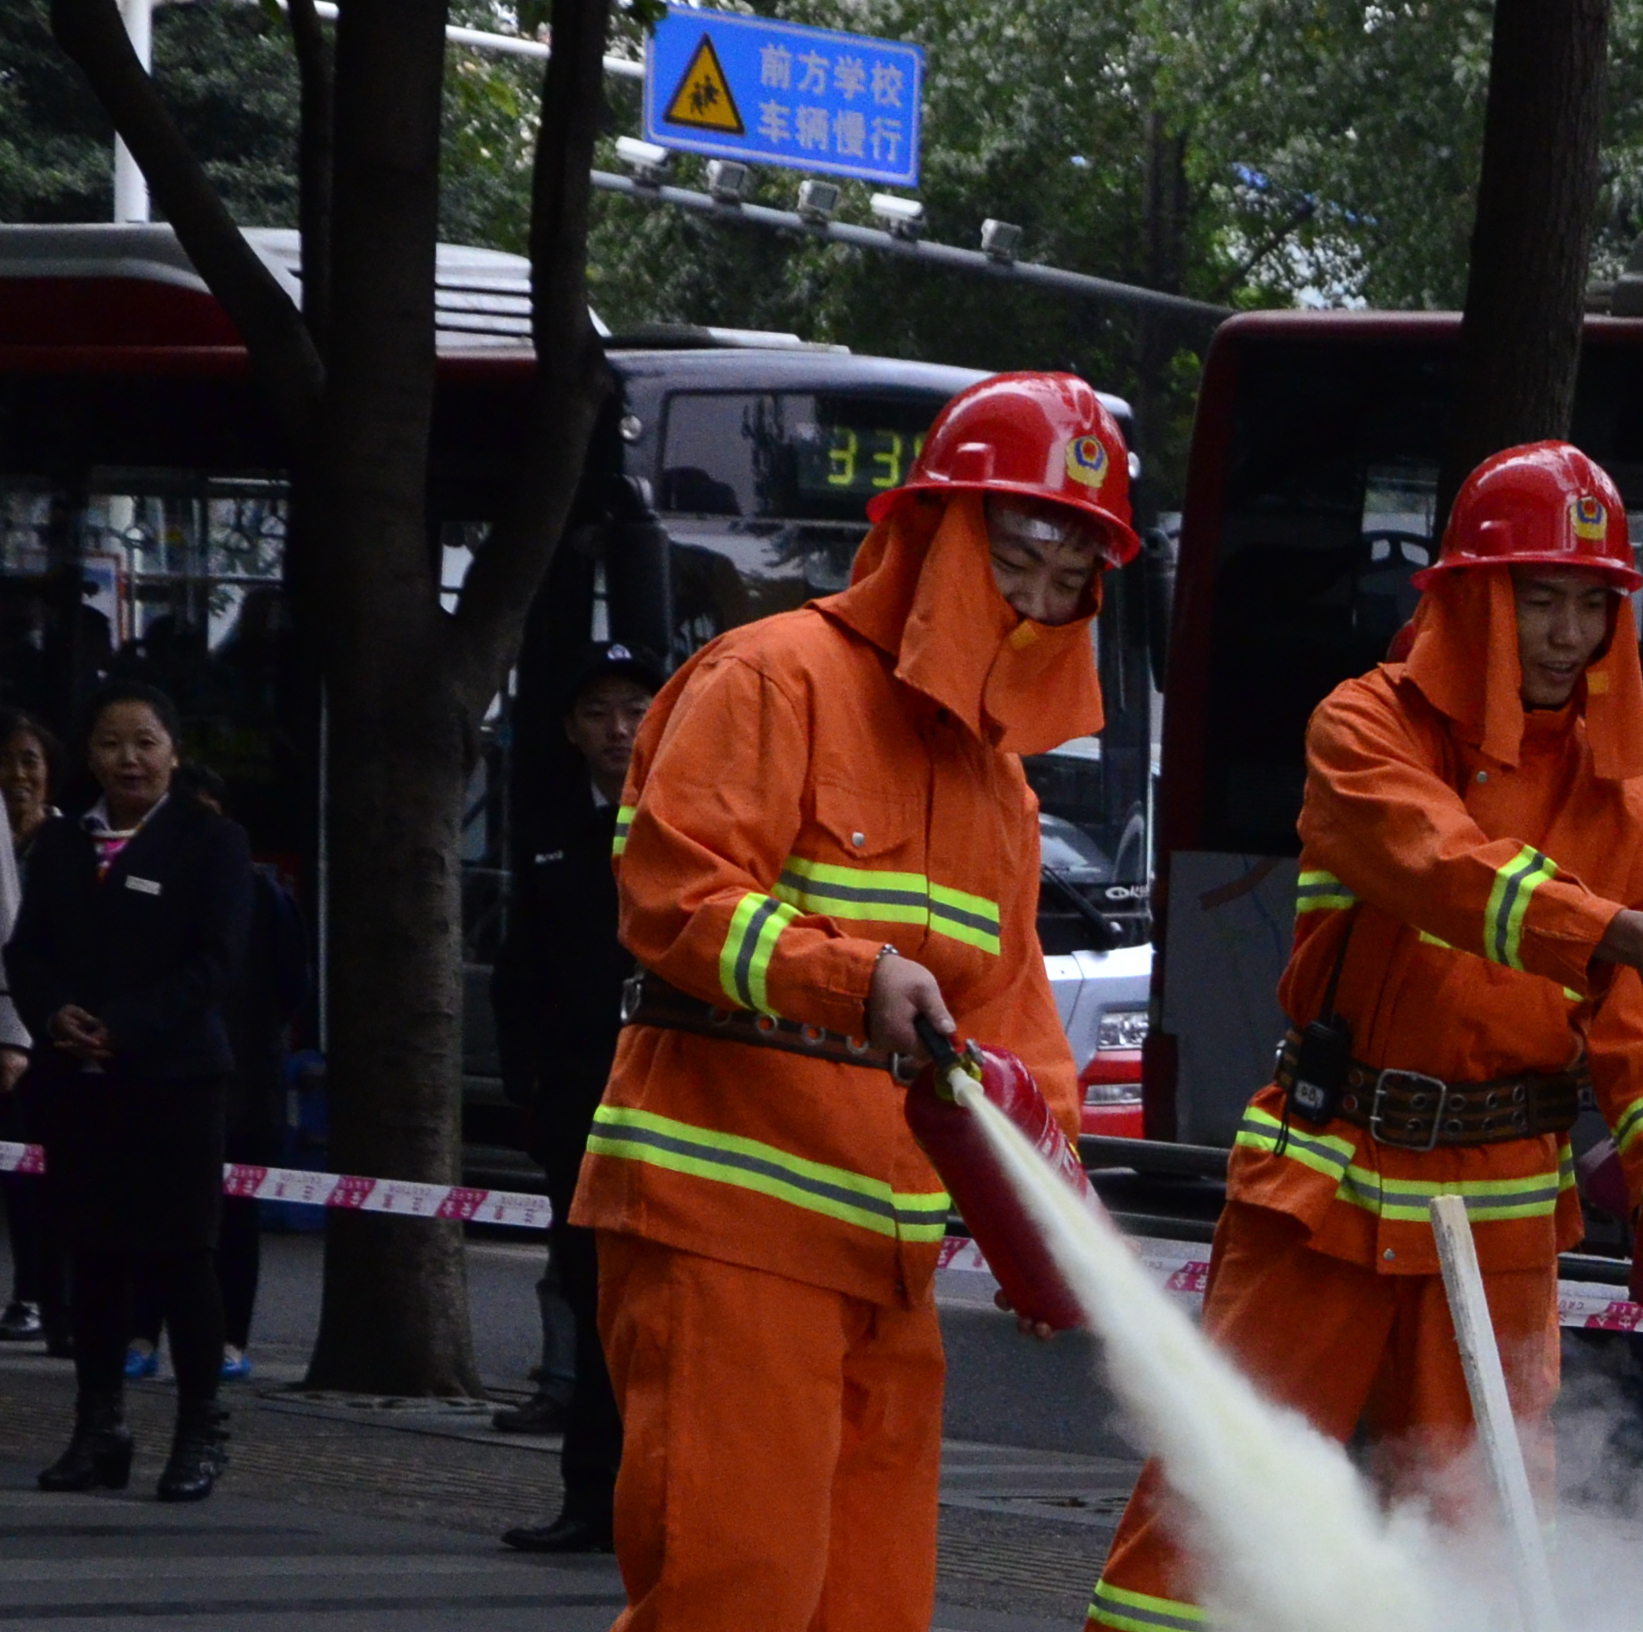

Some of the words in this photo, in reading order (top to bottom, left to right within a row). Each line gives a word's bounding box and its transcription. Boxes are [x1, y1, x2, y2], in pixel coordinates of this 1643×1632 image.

[759, 43, 904, 107] 前方学校
[757, 99, 902, 161] 车辆慢行
